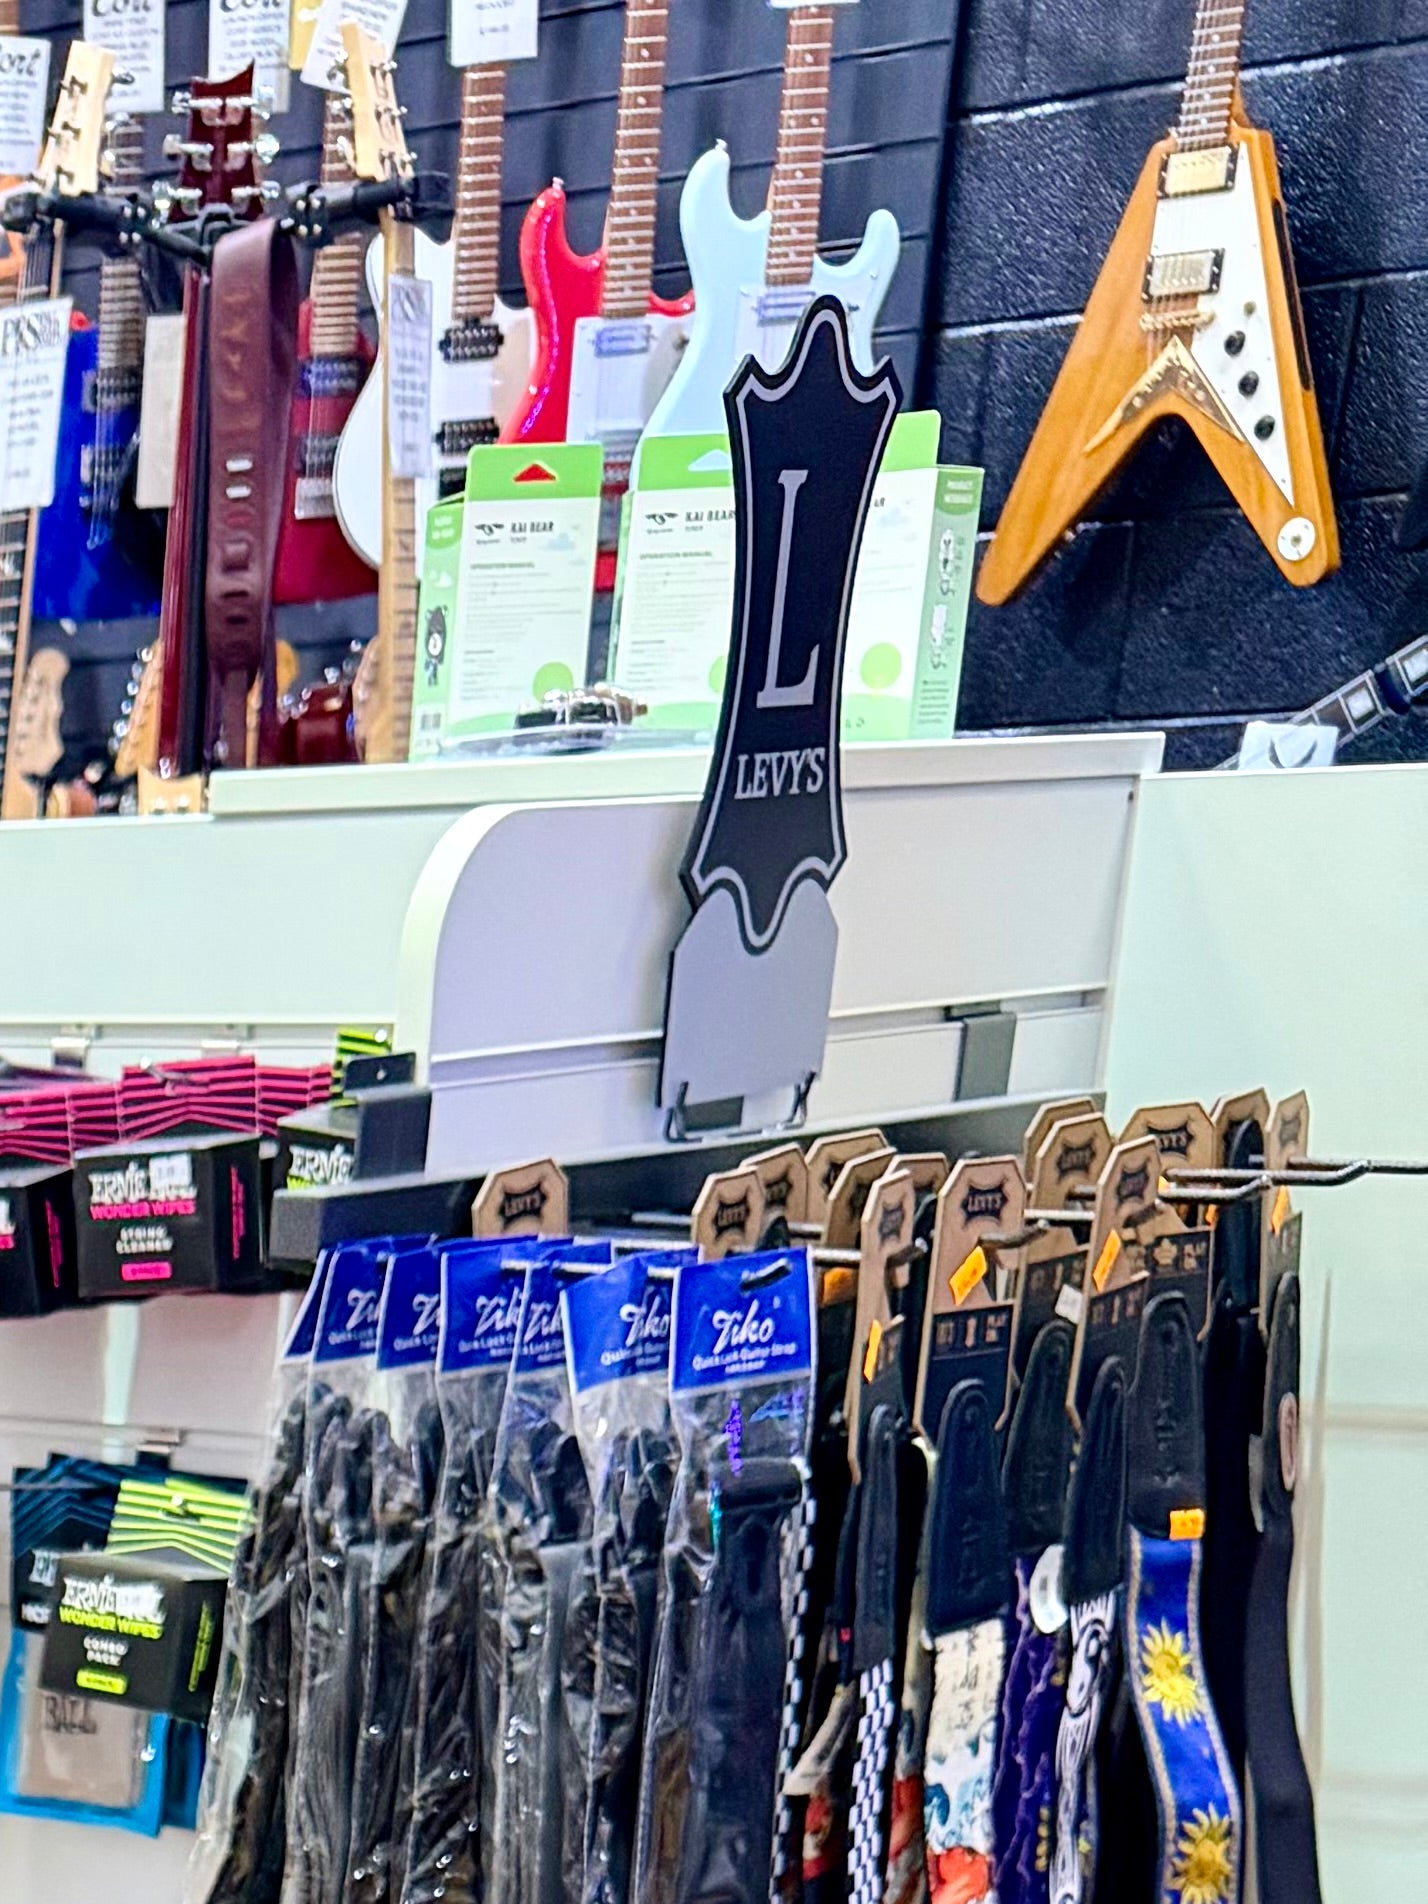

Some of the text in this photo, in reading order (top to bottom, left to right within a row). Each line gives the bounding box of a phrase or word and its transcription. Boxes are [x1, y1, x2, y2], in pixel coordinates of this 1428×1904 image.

[756, 468, 820, 709] L
[734, 747, 825, 799] LEVY'S
[89, 1161, 147, 1204] ERNIE
[288, 1142, 352, 1183] ERNIE
[90, 1199, 197, 1221] WONDER WIPES
[116, 1236, 173, 1255] CLEANER
[59, 1605, 117, 1632] WONDER
[117, 1617, 164, 1640] WIPES
